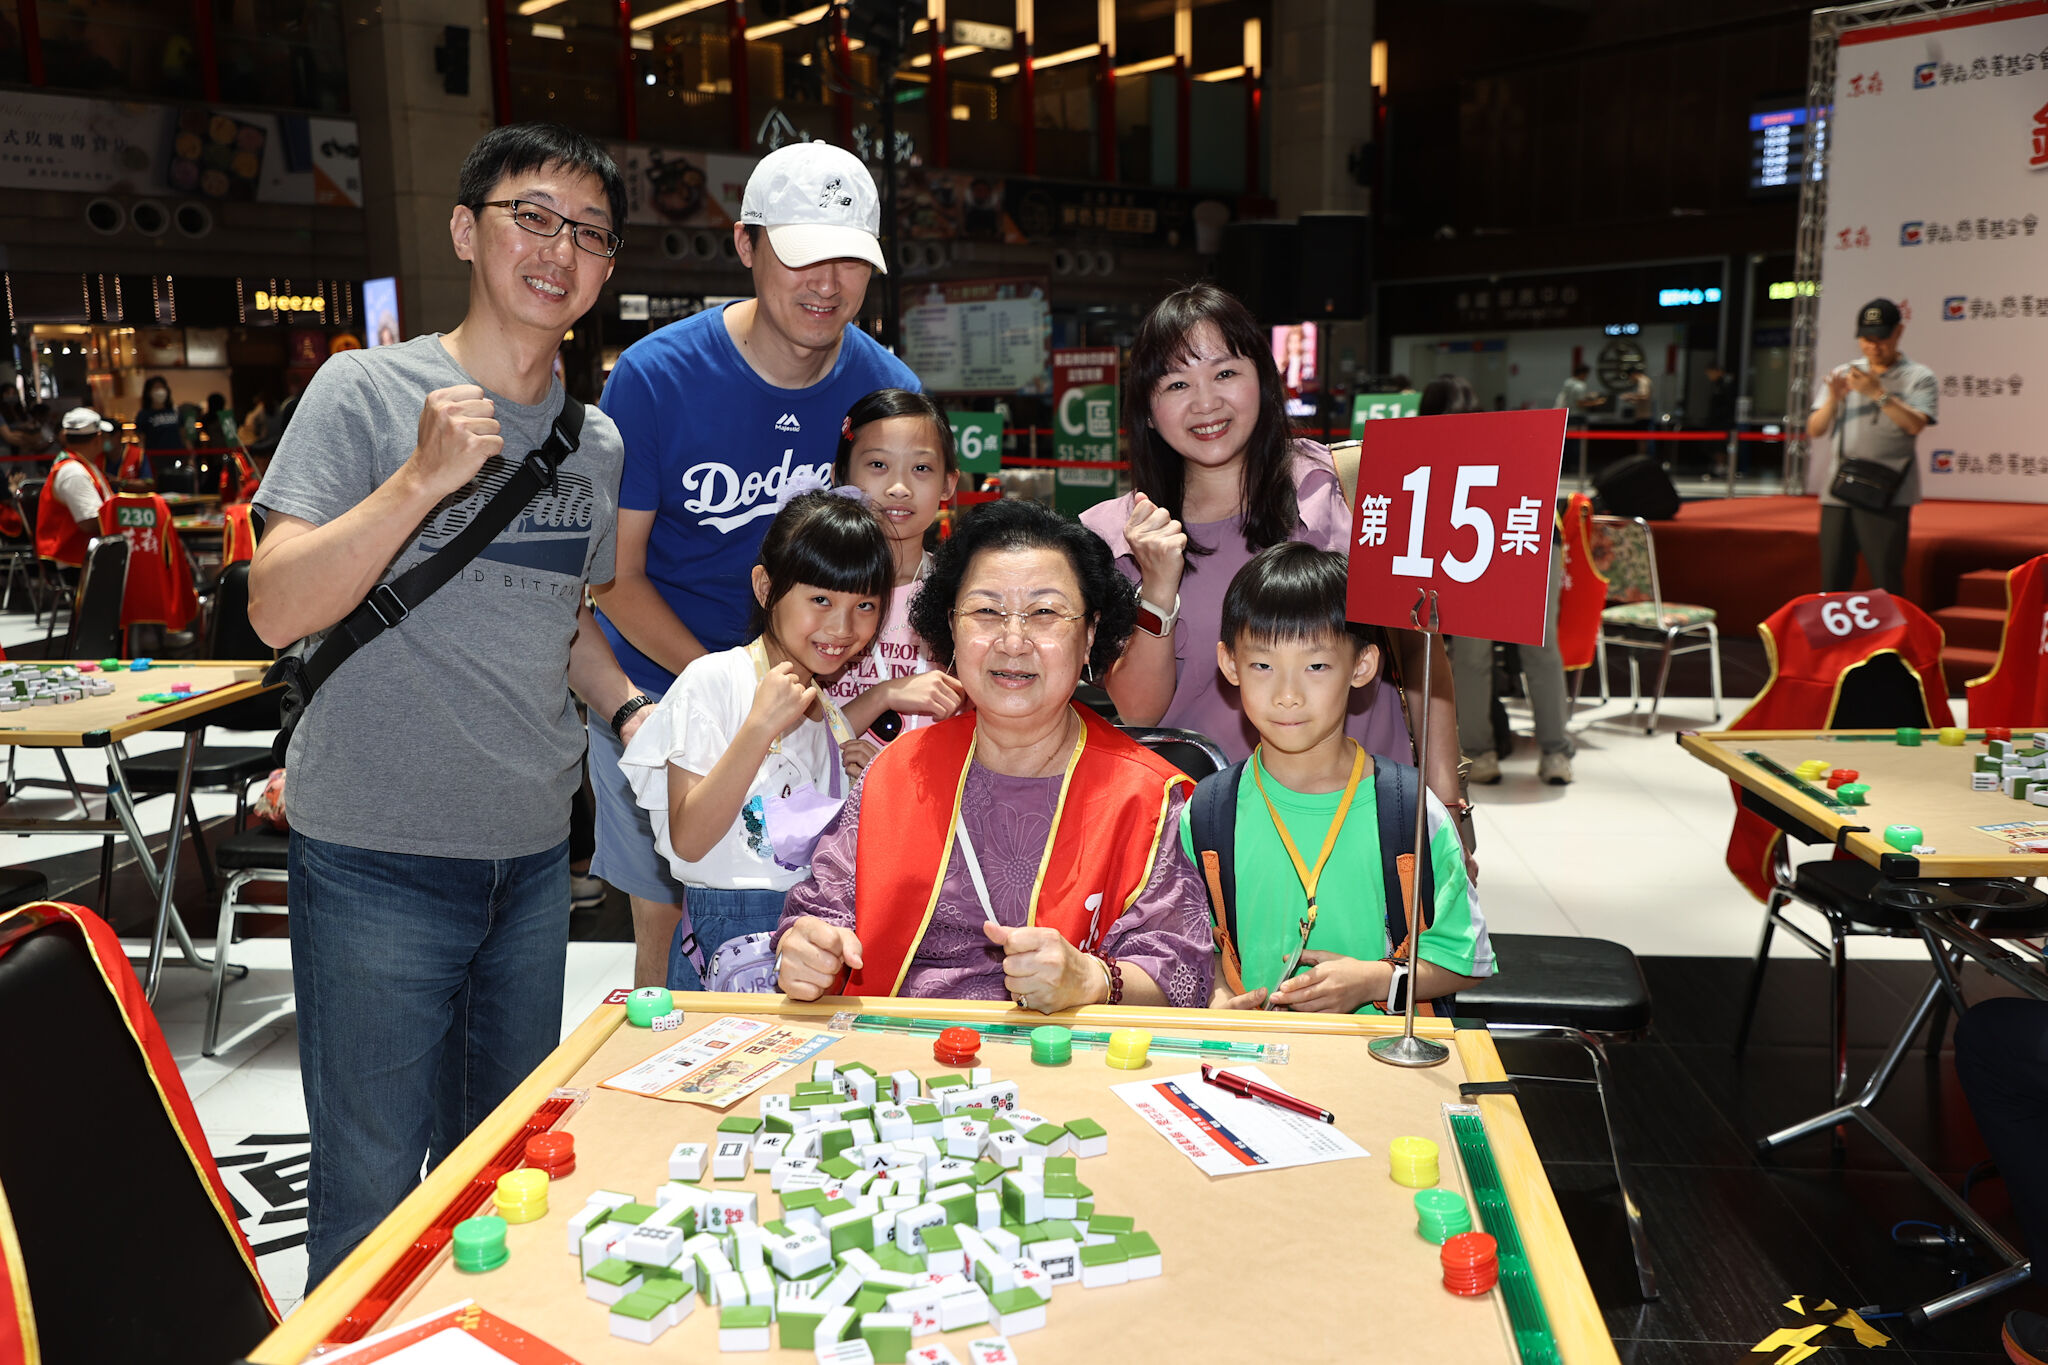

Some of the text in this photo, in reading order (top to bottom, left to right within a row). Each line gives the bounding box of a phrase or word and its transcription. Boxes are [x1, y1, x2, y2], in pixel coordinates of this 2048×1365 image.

[254, 290, 326, 312] Breeze
[774, 423, 801, 433] Majestic
[120, 508, 155, 526] 230
[1359, 464, 1543, 584] 第15桌
[504, 574, 576, 598] BITTON
[847, 660, 918, 681] PLAIN
